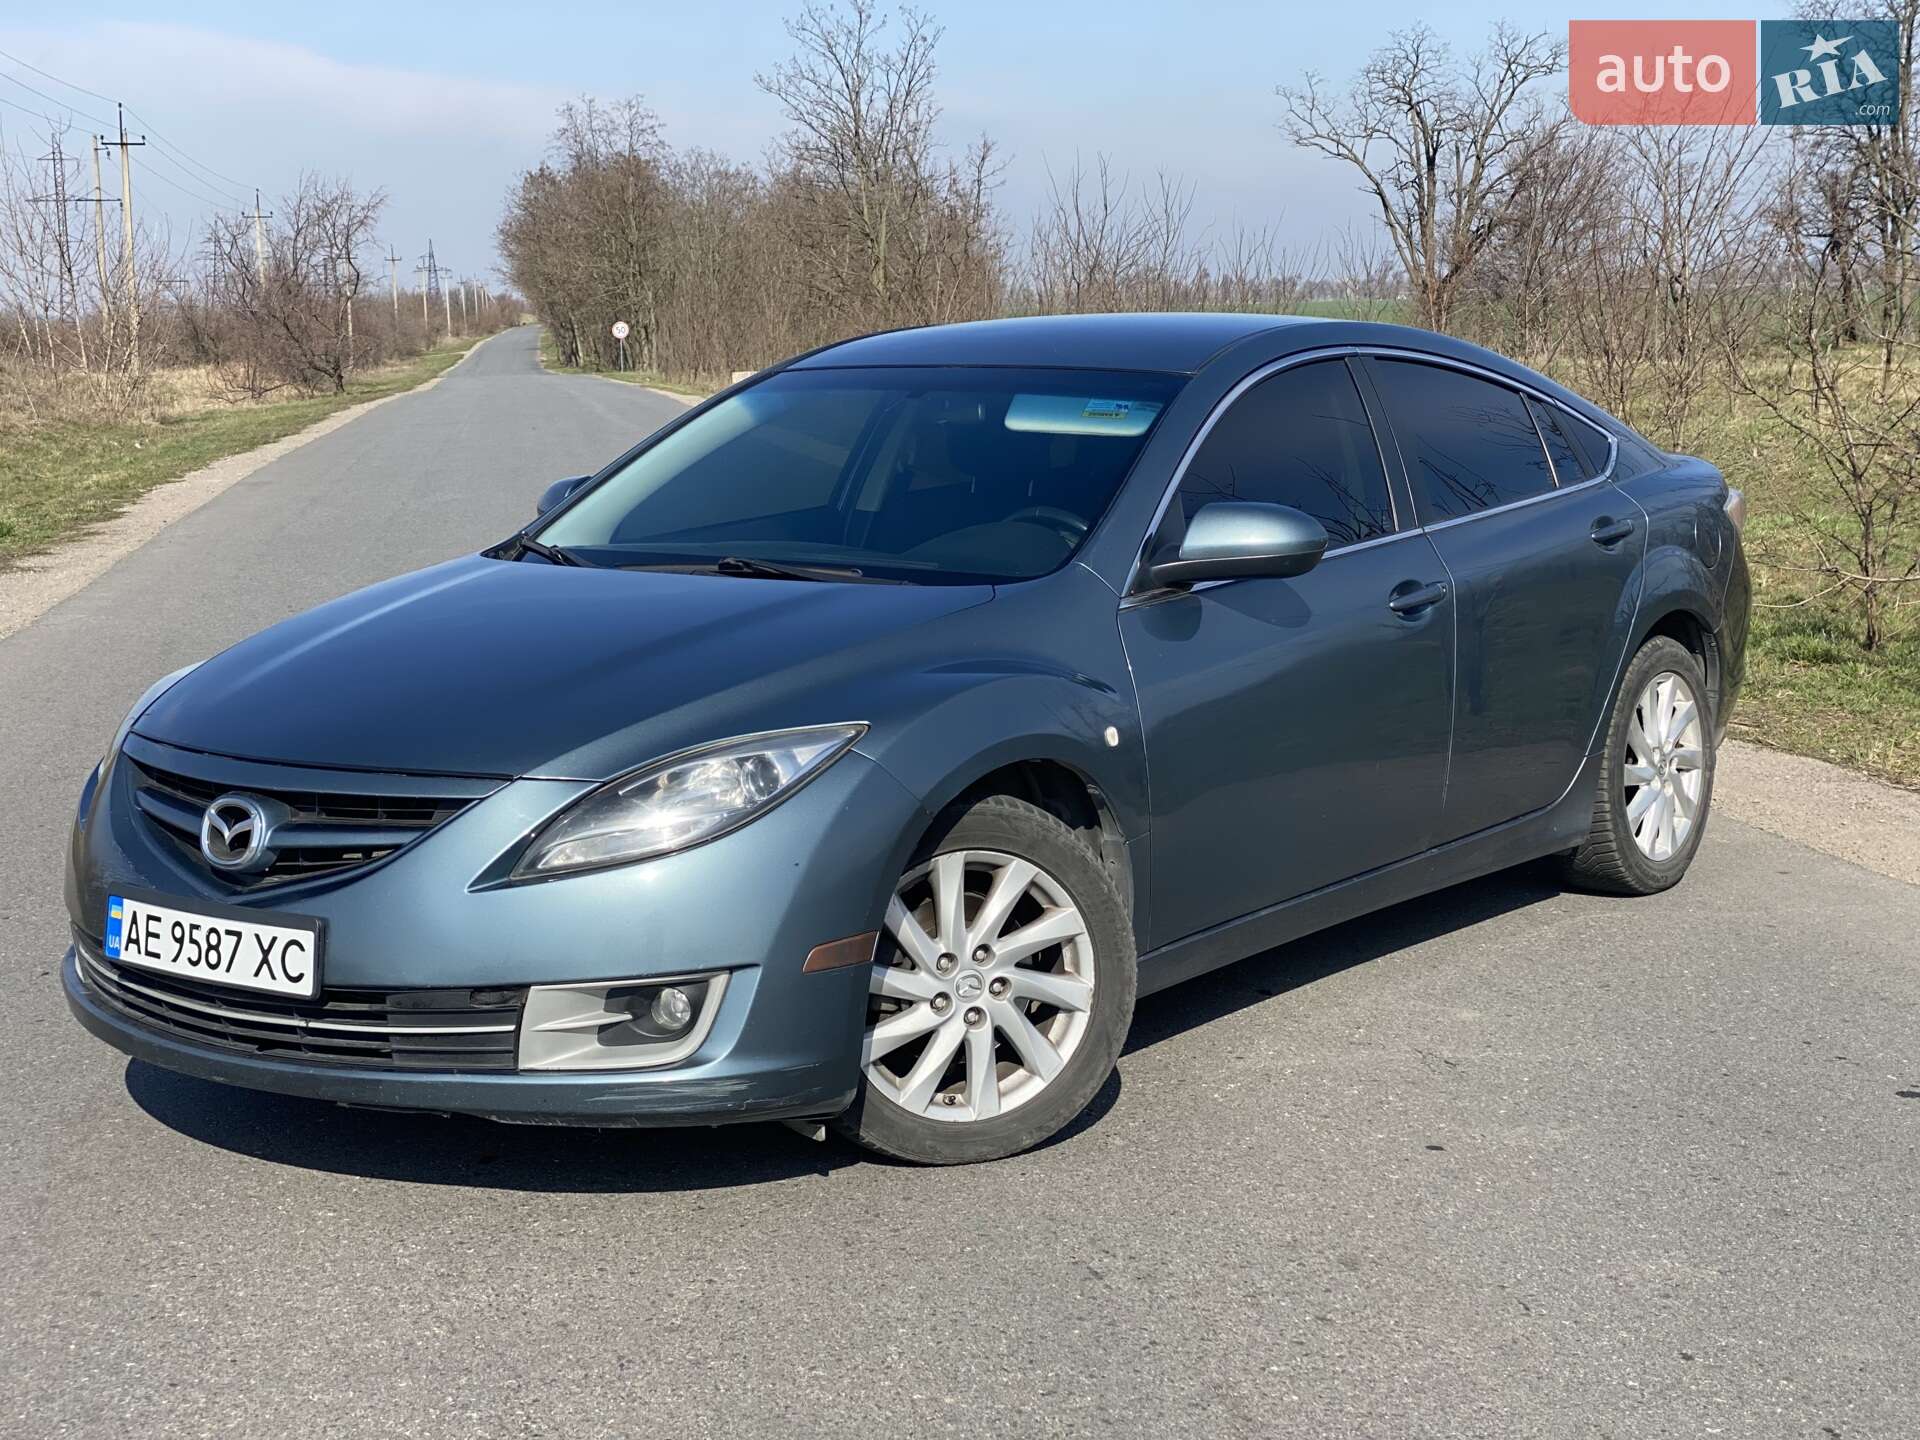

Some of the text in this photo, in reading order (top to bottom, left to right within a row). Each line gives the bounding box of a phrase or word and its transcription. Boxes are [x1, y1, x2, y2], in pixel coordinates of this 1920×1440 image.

[109, 934, 120, 950] UA
[125, 910, 305, 983] AE 9587 XC
